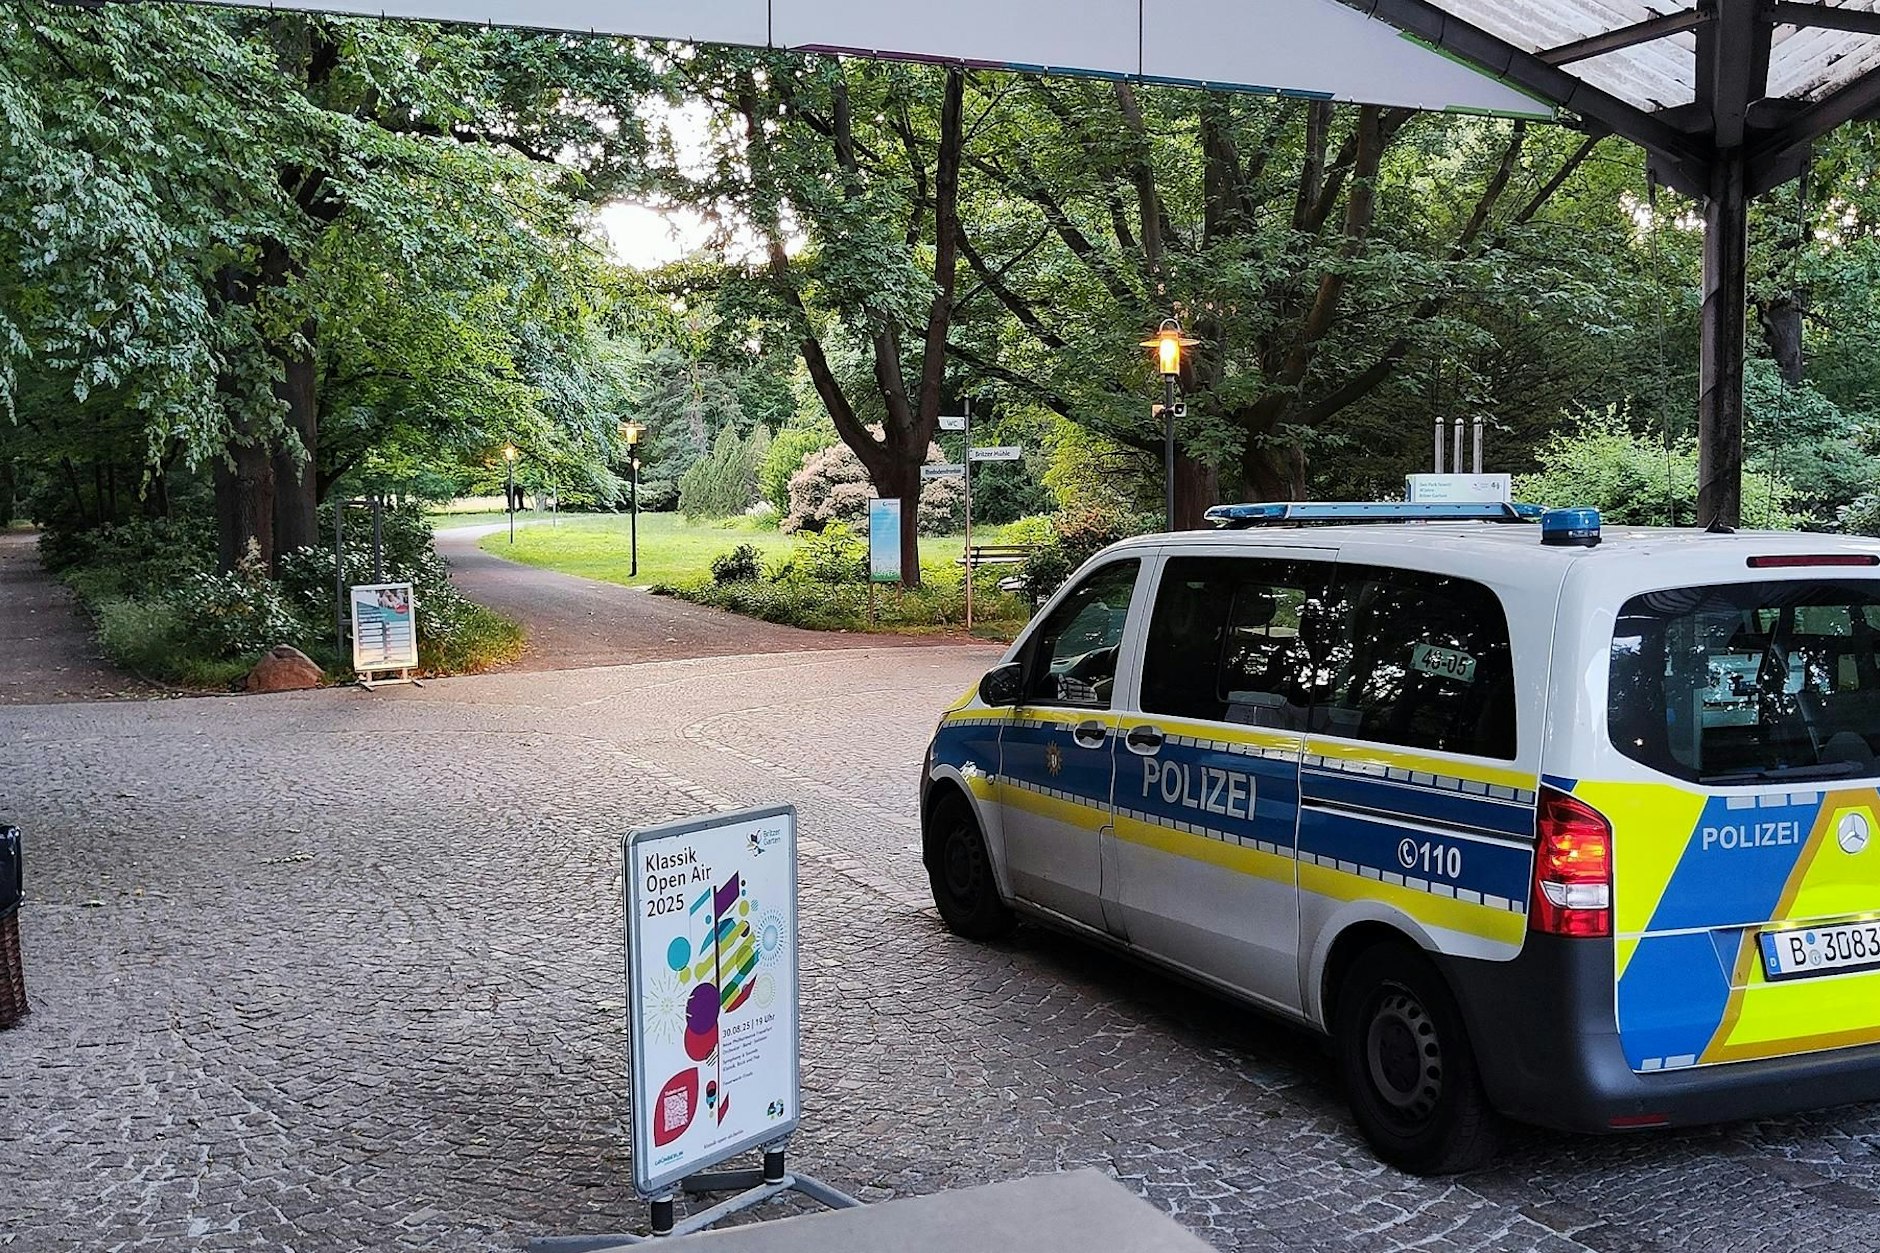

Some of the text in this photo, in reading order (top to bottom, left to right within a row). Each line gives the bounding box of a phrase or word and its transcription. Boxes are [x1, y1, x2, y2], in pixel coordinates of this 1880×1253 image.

[1142, 757, 1257, 821] POLIZEI
[763, 828, 781, 838] Britzer
[763, 836, 781, 846] Garten
[1702, 821, 1799, 850] POLIZEI
[645, 846, 698, 872] Klassik
[1420, 842, 1461, 878] 110
[646, 864, 712, 895] Open Air
[647, 893, 685, 917] 2025
[1789, 928, 1880, 966] B 3083
[1770, 957, 1778, 967] D
[755, 1017, 763, 1026] 19
[764, 1013, 776, 1023] Uhr
